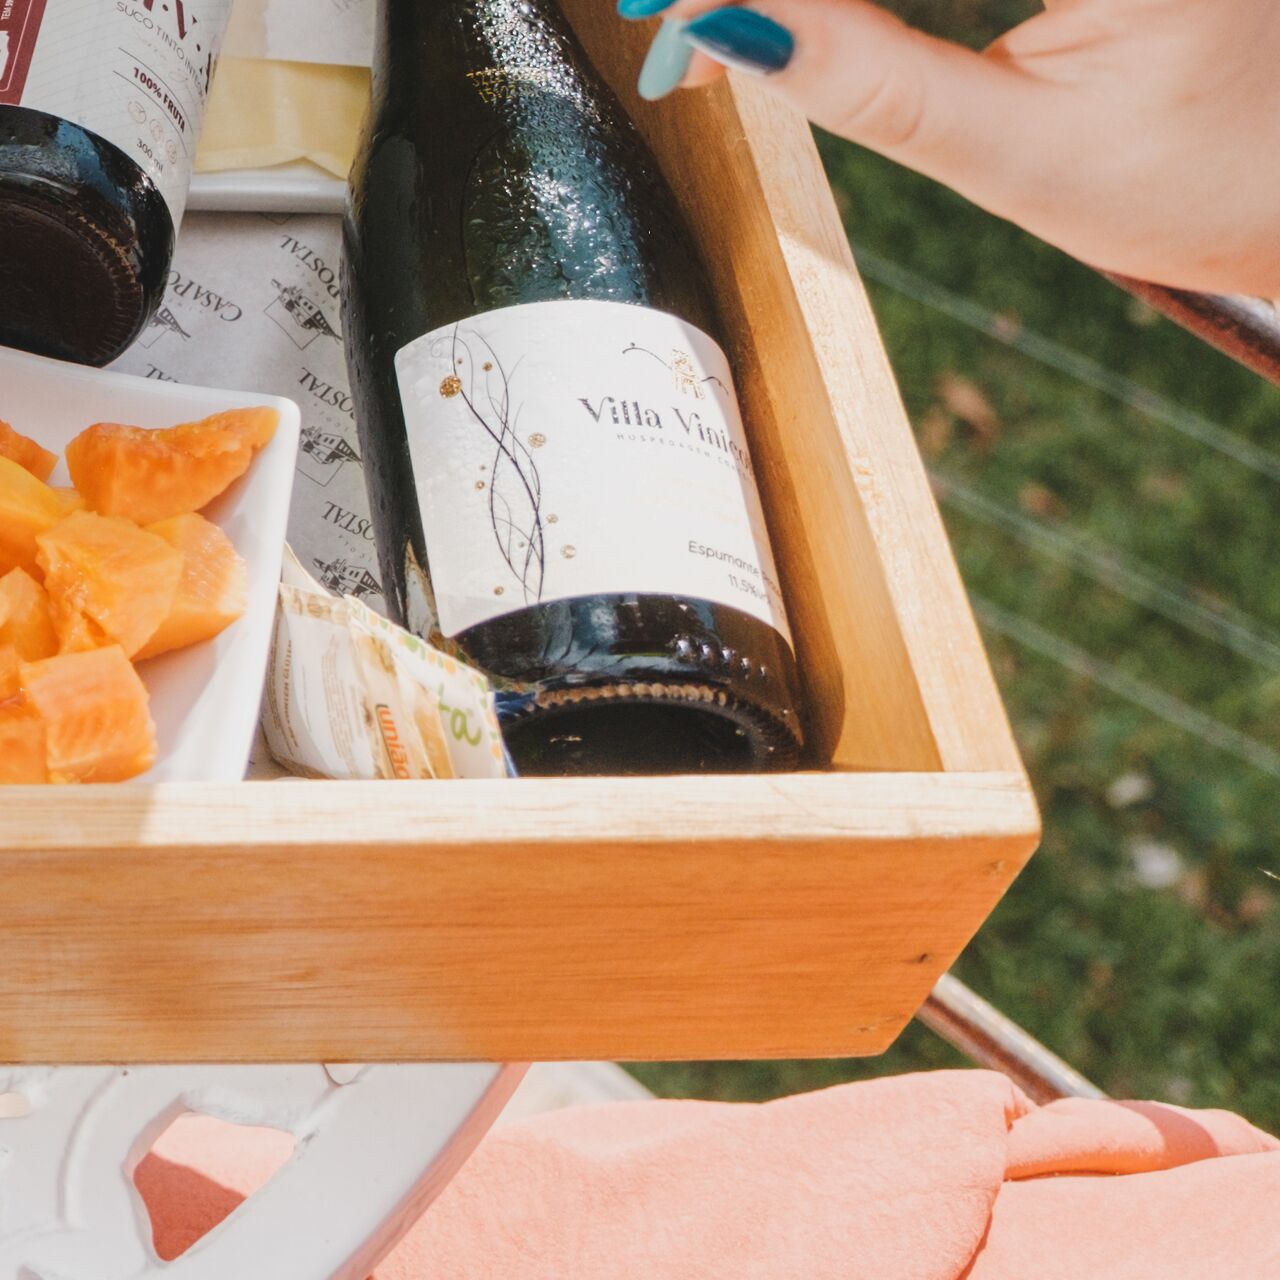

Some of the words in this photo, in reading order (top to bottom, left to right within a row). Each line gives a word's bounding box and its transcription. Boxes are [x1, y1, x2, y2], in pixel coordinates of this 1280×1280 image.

[116, 1, 154, 30] SUCO
[157, 25, 185, 60] TINTO
[133, 66, 162, 98] 100%
[163, 94, 186, 133] FRUTA
[137, 138, 153, 159] 300
[577, 396, 663, 430] Villa
[688, 540, 760, 578] Espumante
